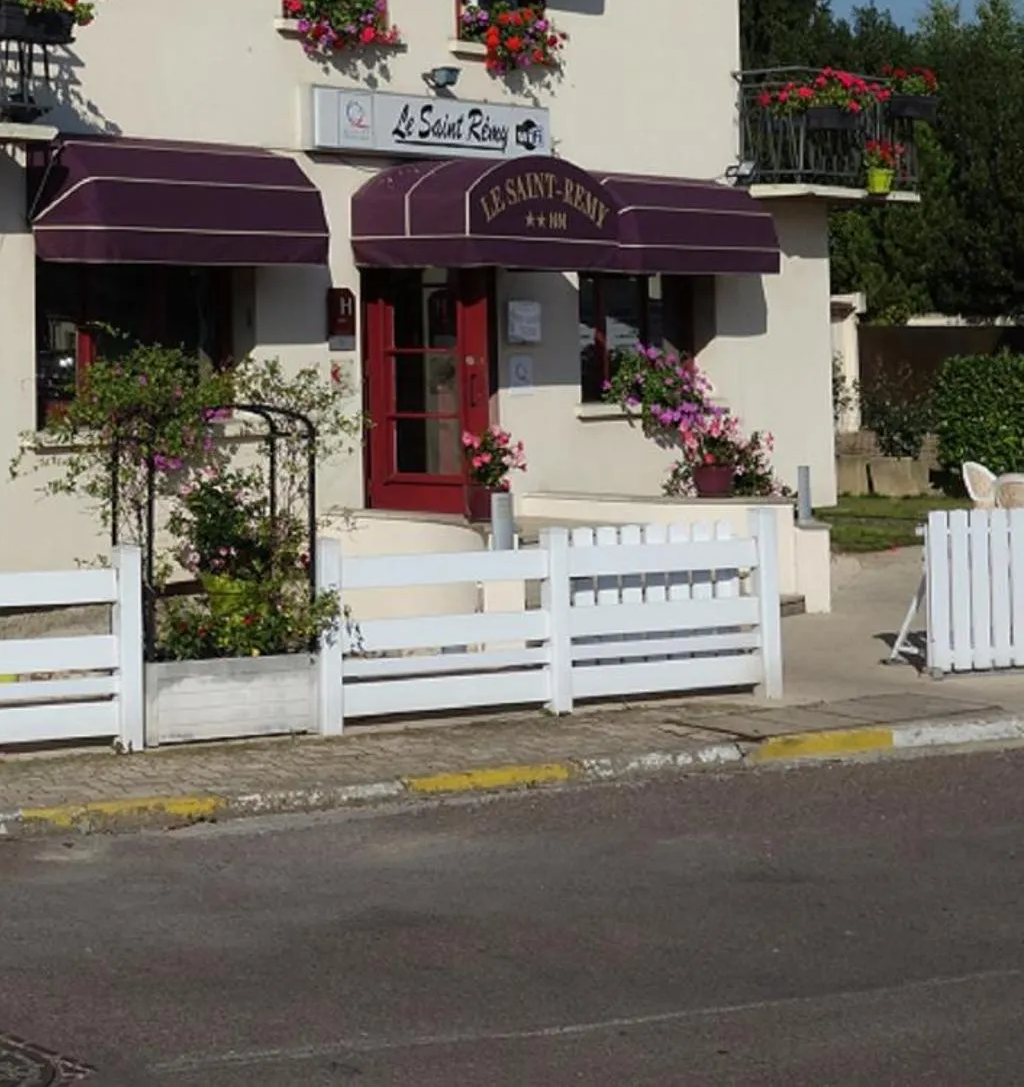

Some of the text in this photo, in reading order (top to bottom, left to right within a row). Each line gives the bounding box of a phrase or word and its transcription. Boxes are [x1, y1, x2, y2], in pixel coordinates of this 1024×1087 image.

[392, 104, 509, 153] Le Saint Rémy
[480, 185, 506, 223] LE
[340, 297, 352, 316] H
